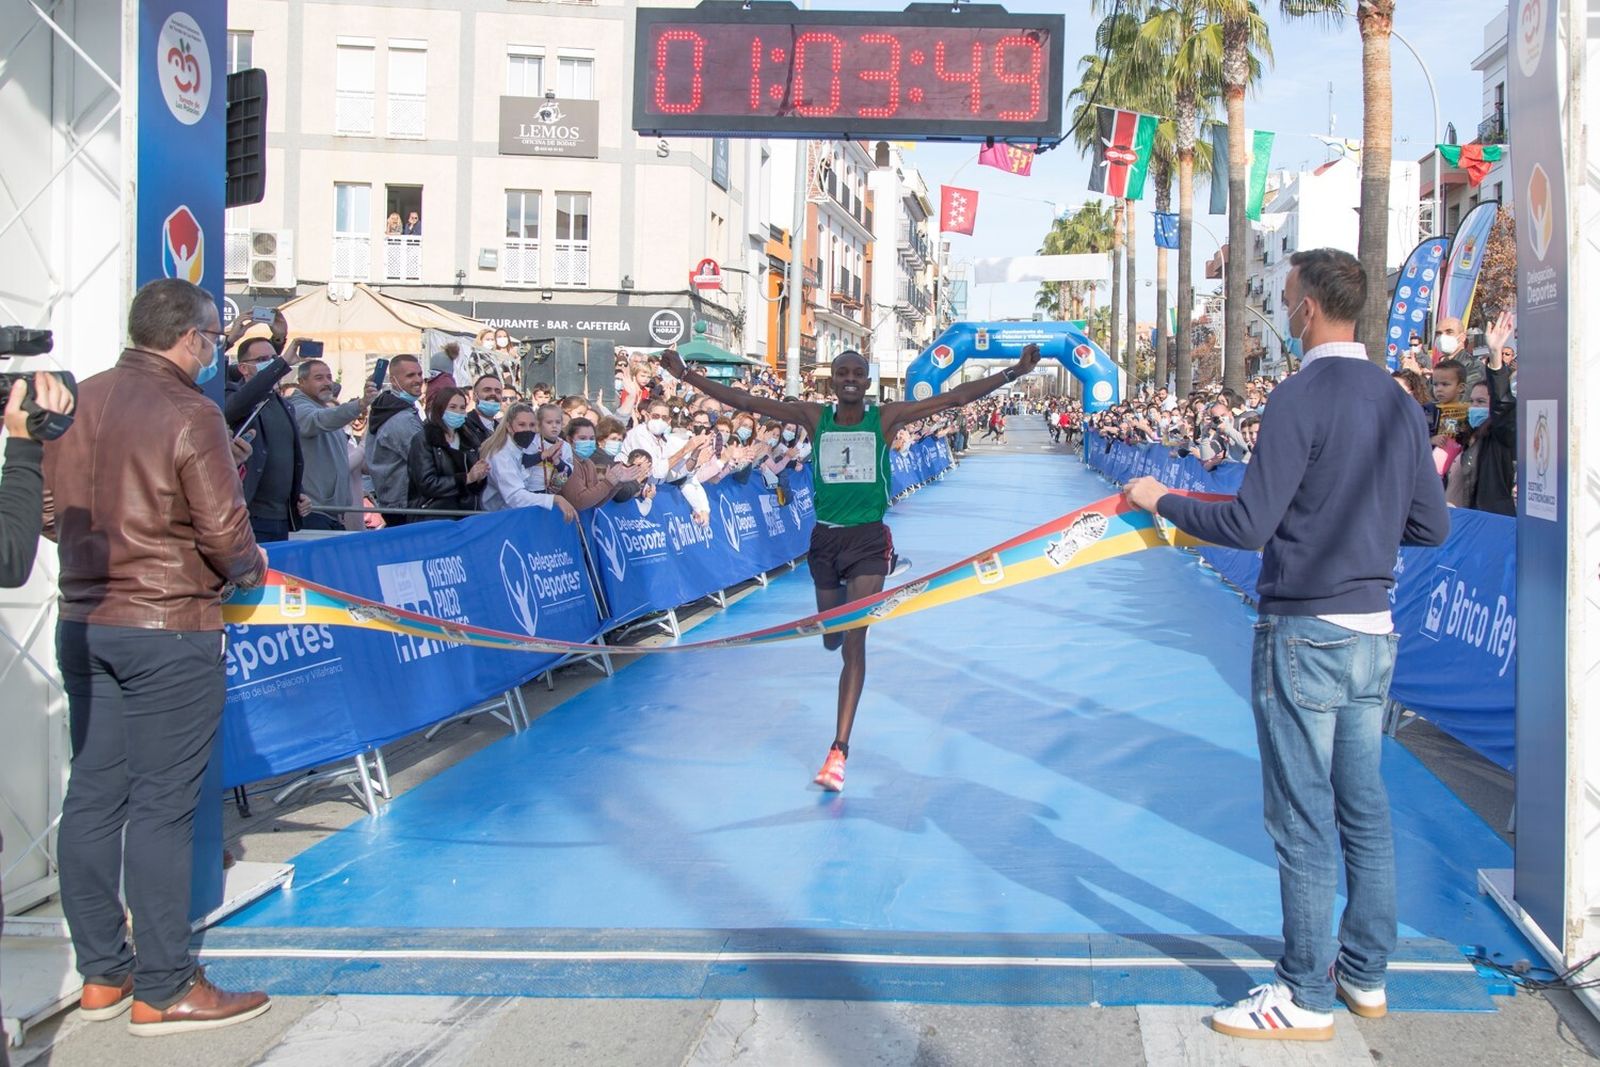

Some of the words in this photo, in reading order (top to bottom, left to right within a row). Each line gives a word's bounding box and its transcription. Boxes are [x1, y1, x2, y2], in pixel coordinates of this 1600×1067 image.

[655, 30, 1042, 121] 01:03:49
[519, 124, 580, 139] LEMOS
[1527, 281, 1557, 305] Deportes
[547, 320, 569, 330] BAR
[576, 319, 631, 331] CAFETERÍA
[841, 446, 850, 465] 1
[426, 555, 467, 588] HIERROS
[527, 547, 568, 573] Delegación
[533, 570, 581, 601] Deportes
[433, 587, 461, 619] PACO
[1446, 580, 1489, 648] Brico
[226, 624, 334, 680] eportes
